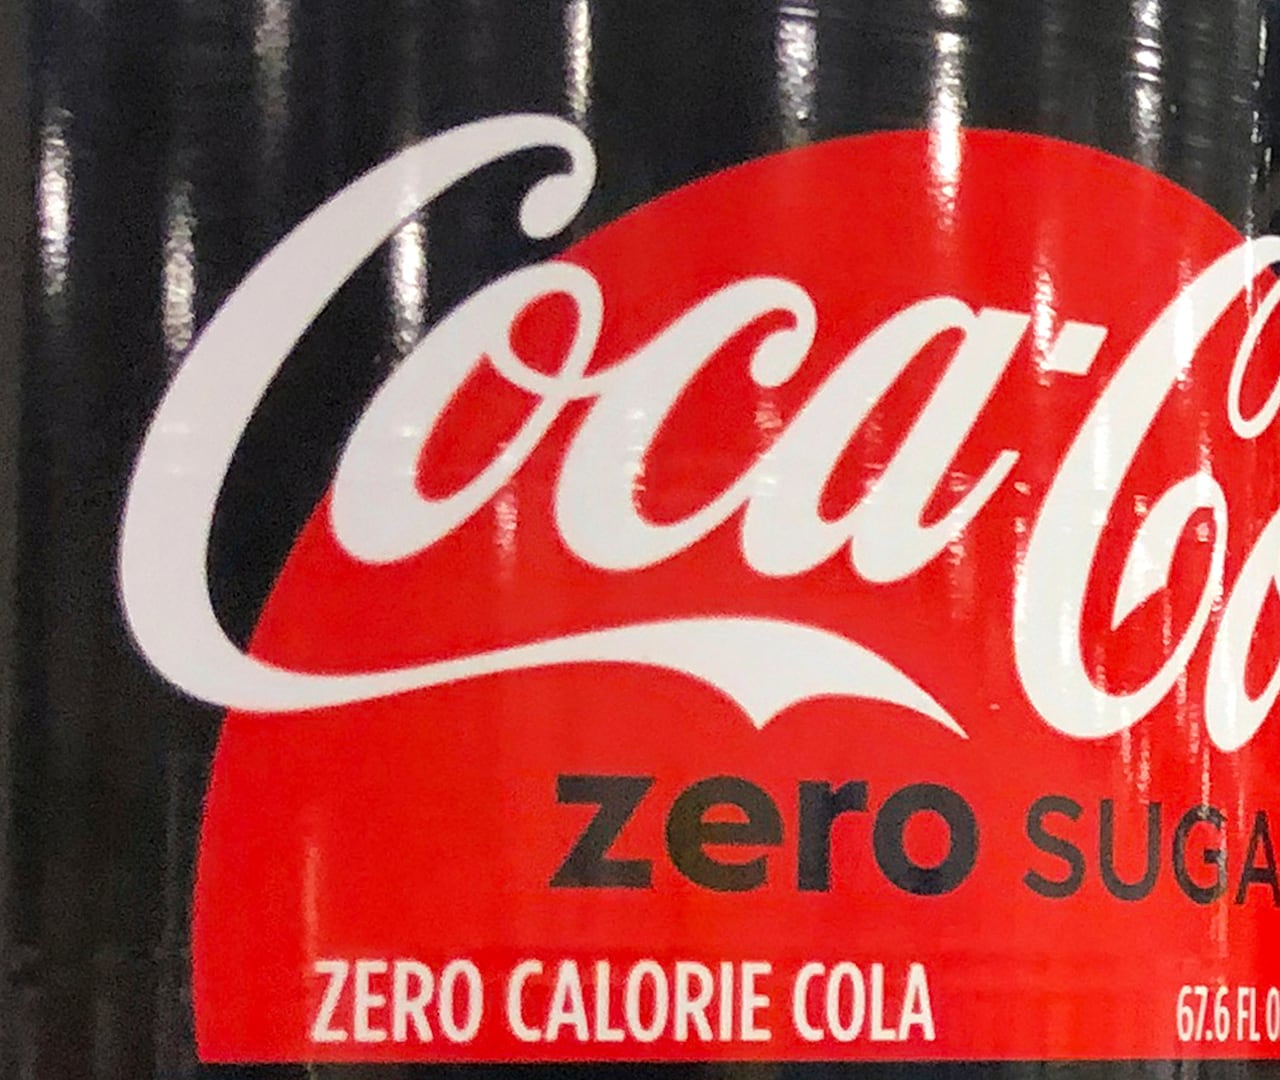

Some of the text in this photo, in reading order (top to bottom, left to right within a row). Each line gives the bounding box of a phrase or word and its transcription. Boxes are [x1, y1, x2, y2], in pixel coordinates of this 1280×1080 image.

[548, 774, 980, 896] zero
[309, 958, 936, 1042] ZERO CALORIE COLA
[1176, 984, 1230, 1043] 67.6
[1236, 986, 1260, 1042] FL
